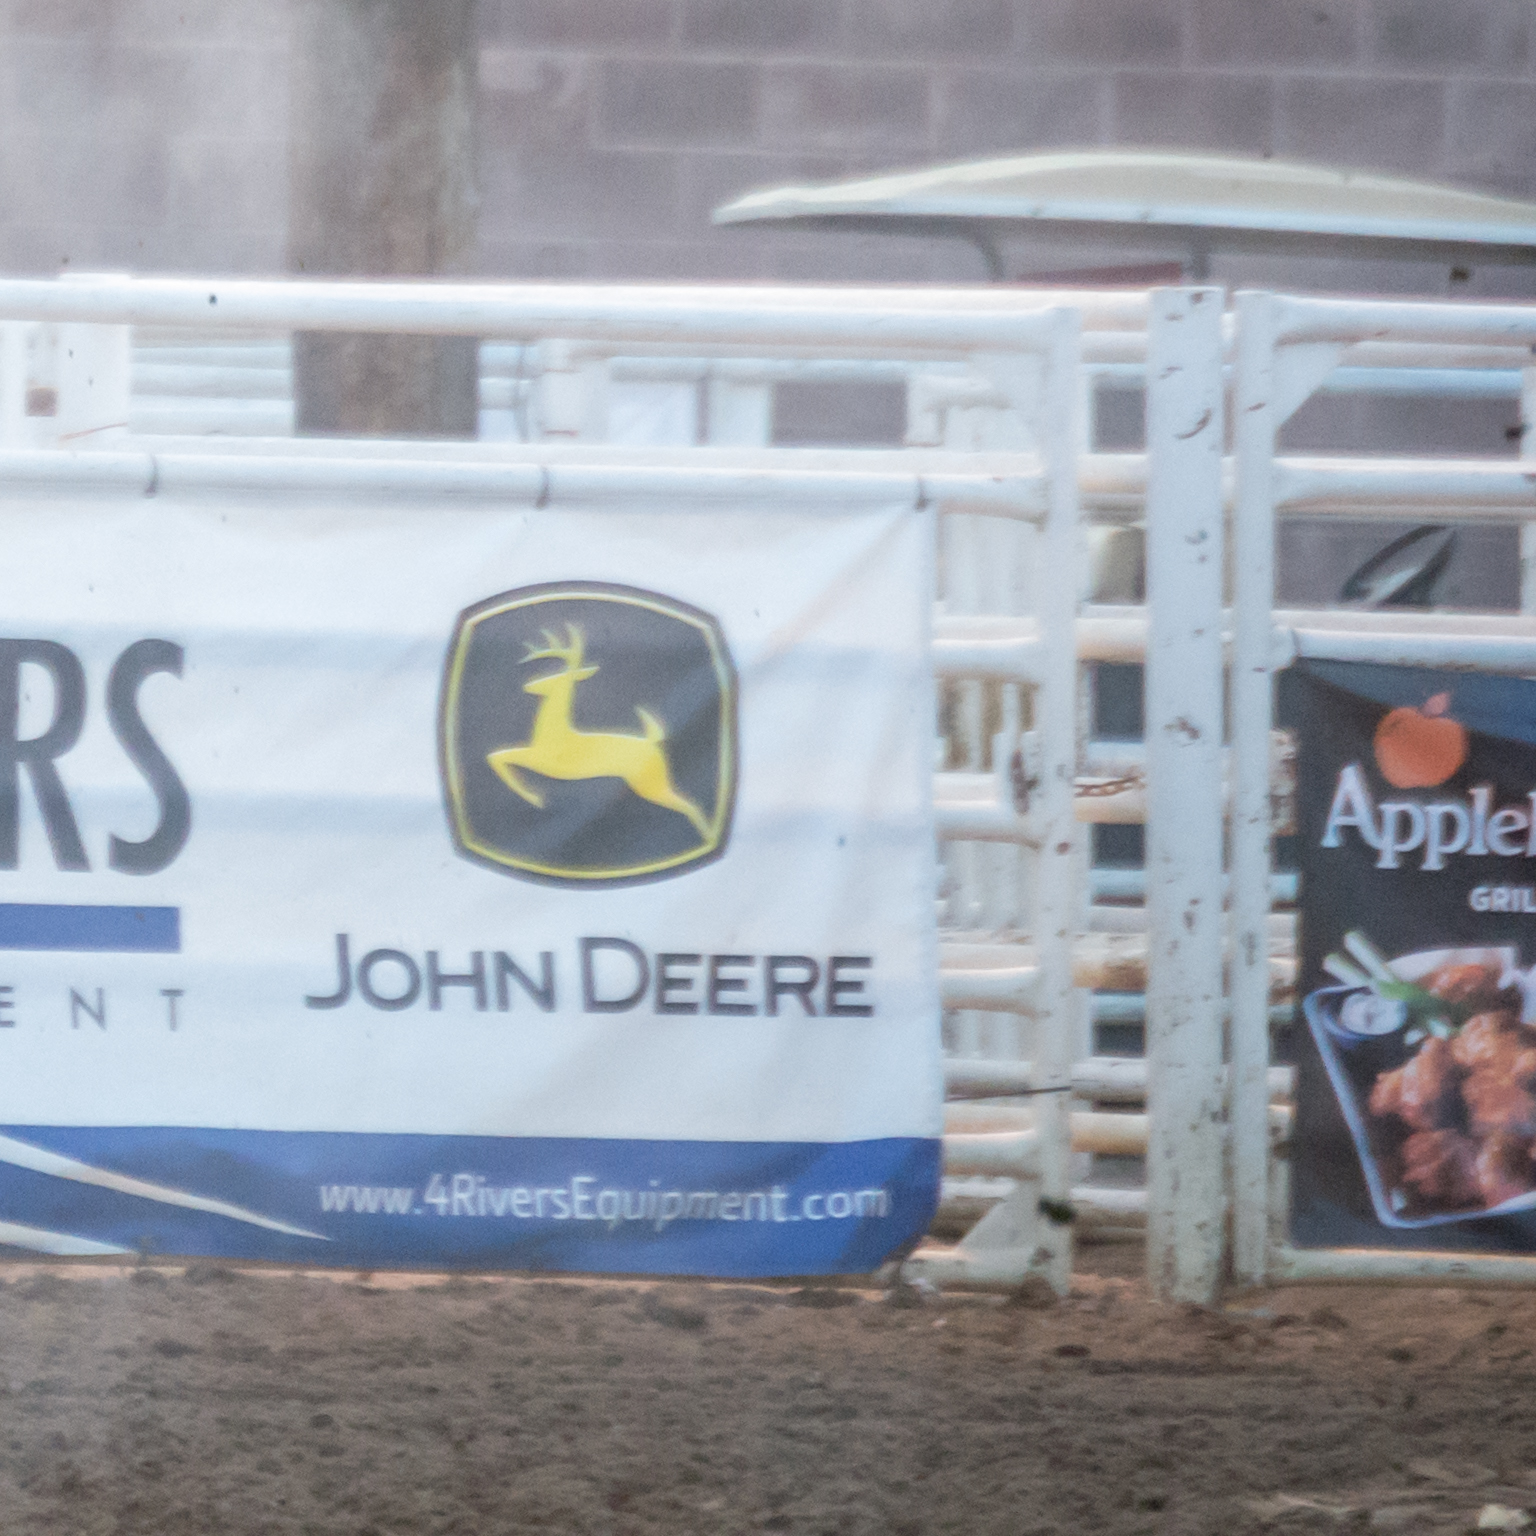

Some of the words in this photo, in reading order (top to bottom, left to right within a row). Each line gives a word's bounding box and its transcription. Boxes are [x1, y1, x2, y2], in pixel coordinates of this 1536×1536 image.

[1320, 763, 1536, 871] Apple
[305, 932, 556, 1014] JOHN
[578, 937, 874, 1019] DEERE
[320, 1172, 890, 1232] www.4RiversEquipment.com
